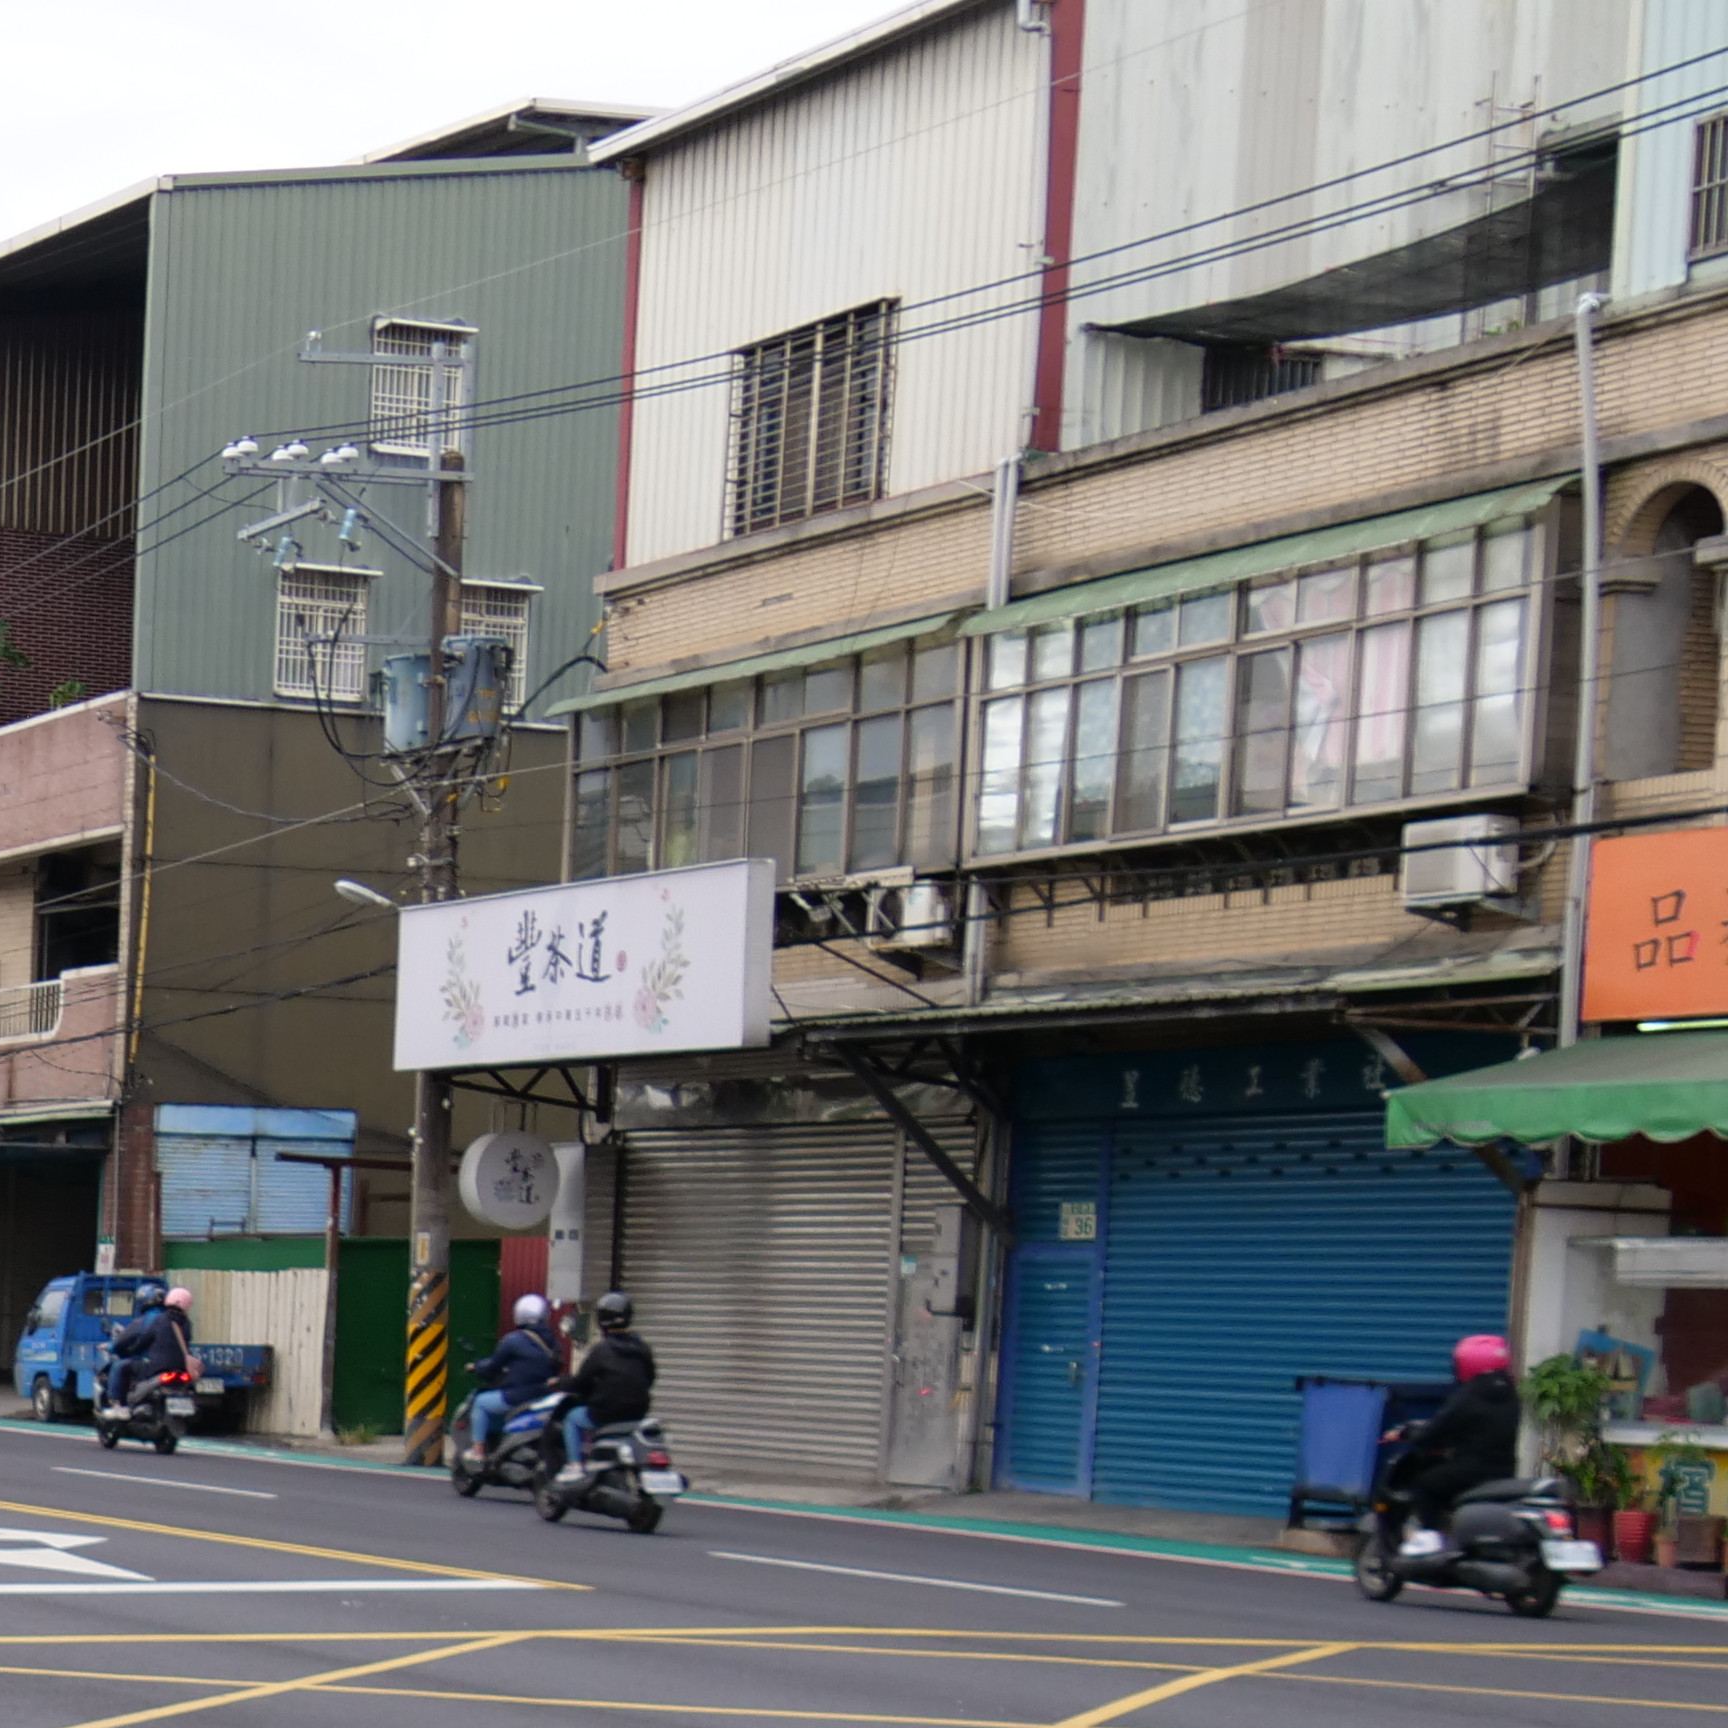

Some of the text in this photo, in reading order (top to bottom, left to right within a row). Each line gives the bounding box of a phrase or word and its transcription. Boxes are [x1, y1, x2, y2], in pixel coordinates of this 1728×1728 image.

[508, 909, 612, 996] 豐茶道
[1074, 1216, 1093, 1235] 36
